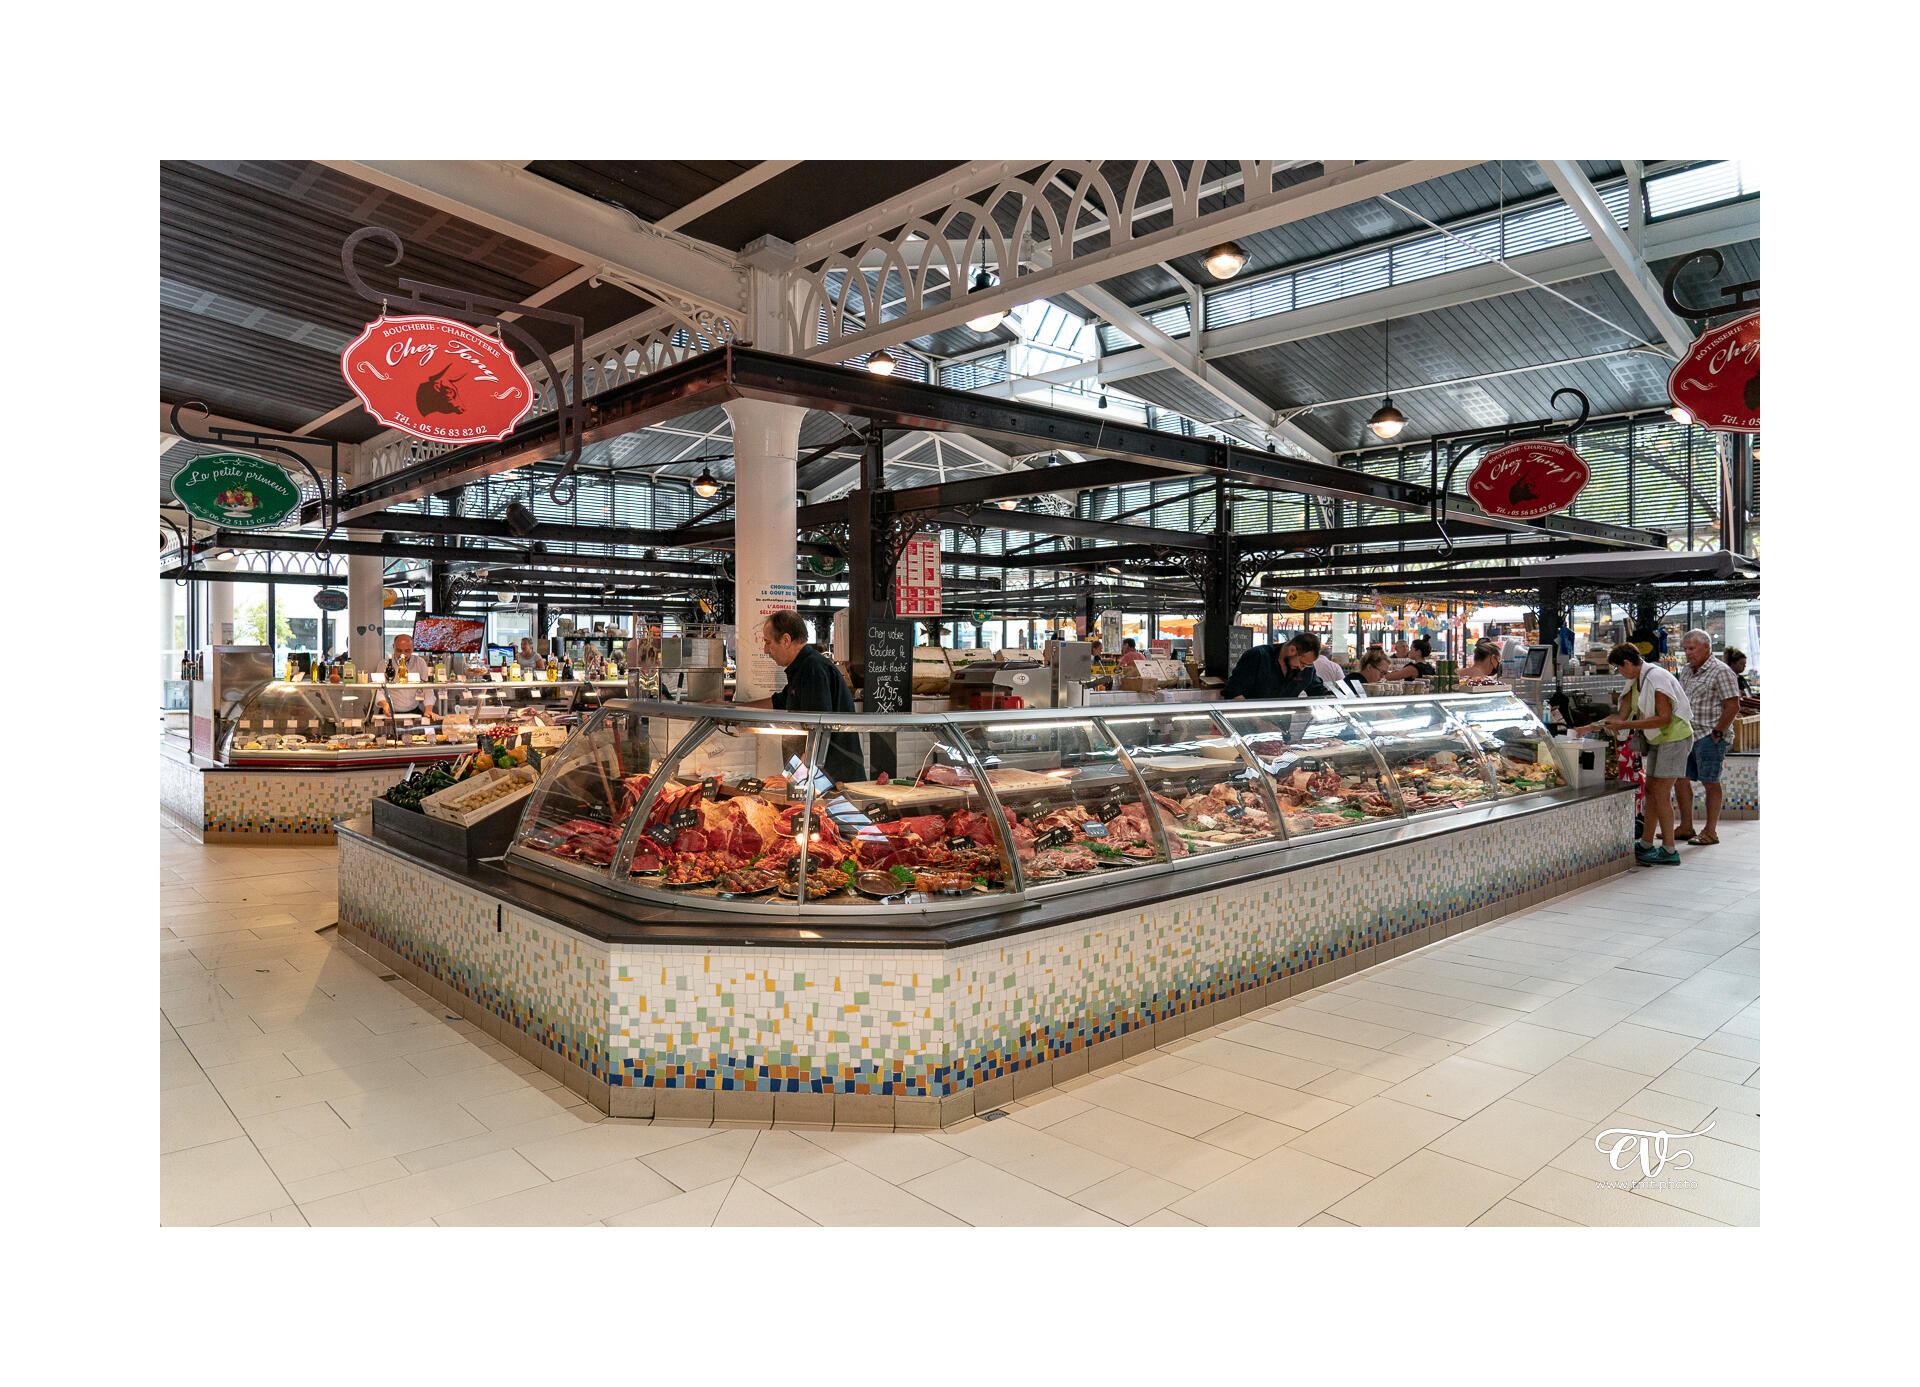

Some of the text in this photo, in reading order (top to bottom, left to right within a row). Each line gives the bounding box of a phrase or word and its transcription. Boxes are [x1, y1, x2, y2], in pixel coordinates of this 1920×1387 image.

[382, 323, 435, 337] BOUCHERIE
[442, 325, 501, 358] CHARCUTERIE
[386, 337, 500, 383] Chez Tony
[1709, 340, 1760, 375] Chez
[394, 412, 410, 426] Tél.
[420, 423, 432, 433] 05
[434, 427, 446, 436] 56
[448, 428, 460, 437] 83
[462, 428, 474, 436] 82
[476, 425, 488, 435] 02
[1488, 446, 1520, 464] BOUCHERIE
[1524, 444, 1566, 456] CHARCUTERIE
[1490, 452, 1564, 480] Chez Tony
[186, 466, 289, 496] La petite primeur
[210, 513, 220, 521] 06
[1548, 502, 1557, 510] 02
[868, 626, 904, 648] Chez votre
